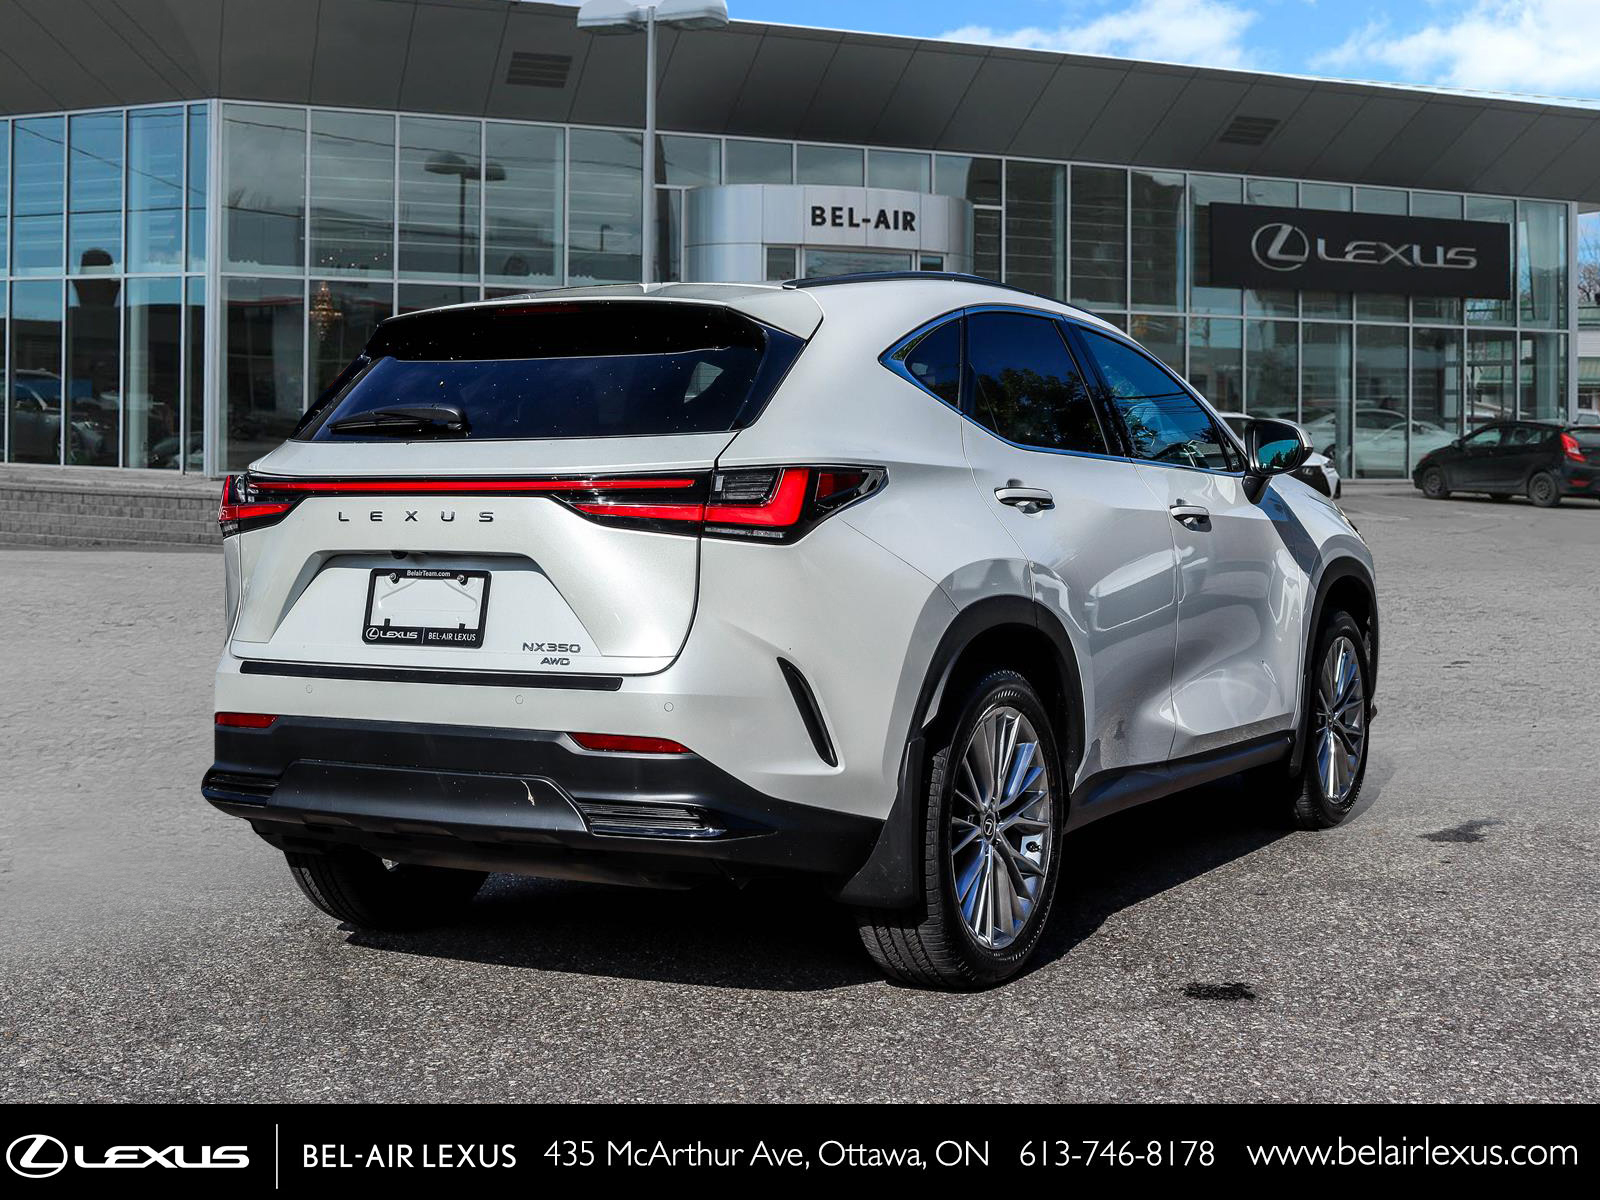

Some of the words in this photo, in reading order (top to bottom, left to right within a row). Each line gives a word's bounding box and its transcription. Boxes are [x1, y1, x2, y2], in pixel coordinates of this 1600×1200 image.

[811, 205, 916, 232] BEL-AIR
[1316, 237, 1478, 270] LEXUS
[338, 510, 495, 523] LEXUS
[406, 570, 451, 578] BelairTeam.com
[380, 631, 419, 640] LEXUS
[428, 633, 453, 641] BEL-AIR
[454, 633, 477, 642] LEXUS
[522, 642, 581, 653] NX350
[540, 657, 571, 666] AWD
